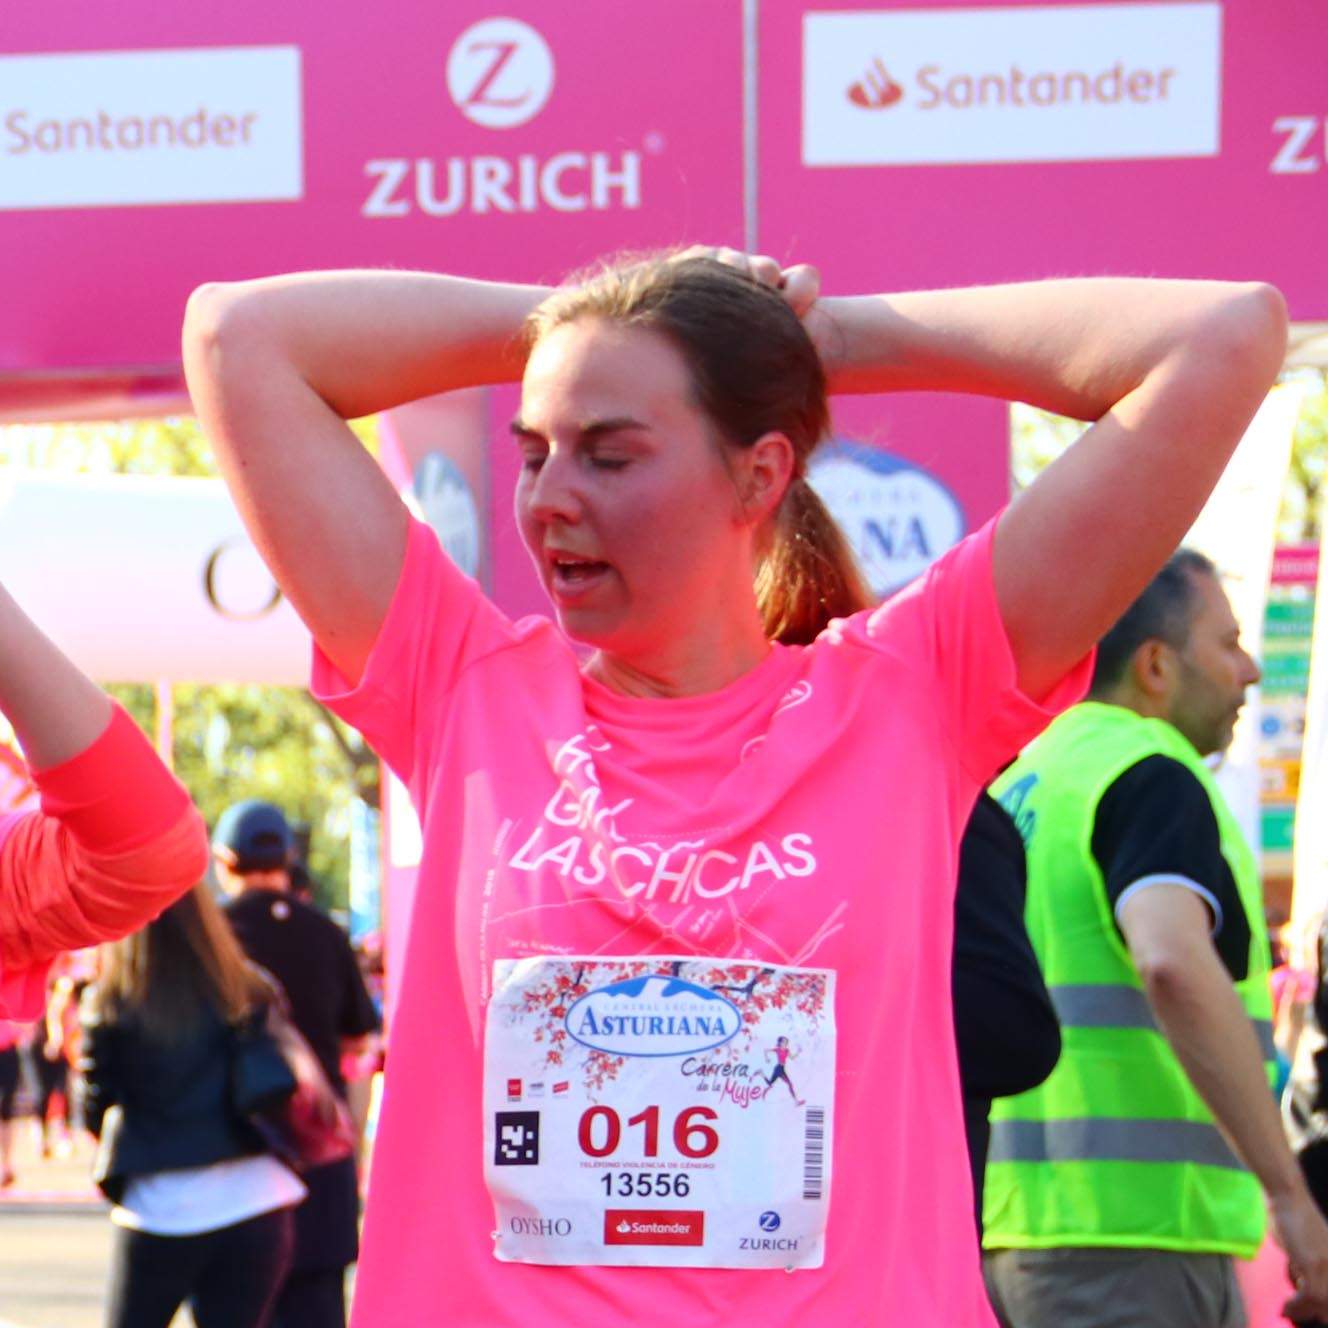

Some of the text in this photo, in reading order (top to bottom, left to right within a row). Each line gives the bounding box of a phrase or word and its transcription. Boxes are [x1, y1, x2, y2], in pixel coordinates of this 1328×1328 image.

[915, 62, 1178, 111] Santander
[4, 105, 258, 155] Santander
[1269, 115, 1328, 174] Z
[361, 151, 641, 217] ZURICH
[508, 825, 607, 887] LAS
[578, 1006, 727, 1037] ASTURIANA
[681, 1056, 748, 1078] Carrera
[718, 1074, 772, 1109] Mujer
[577, 1105, 721, 1159] 016
[601, 1172, 690, 1197] 13556
[510, 1217, 572, 1237] OYSHO
[632, 1221, 691, 1234] Santander
[740, 1237, 798, 1251] ZURICH
